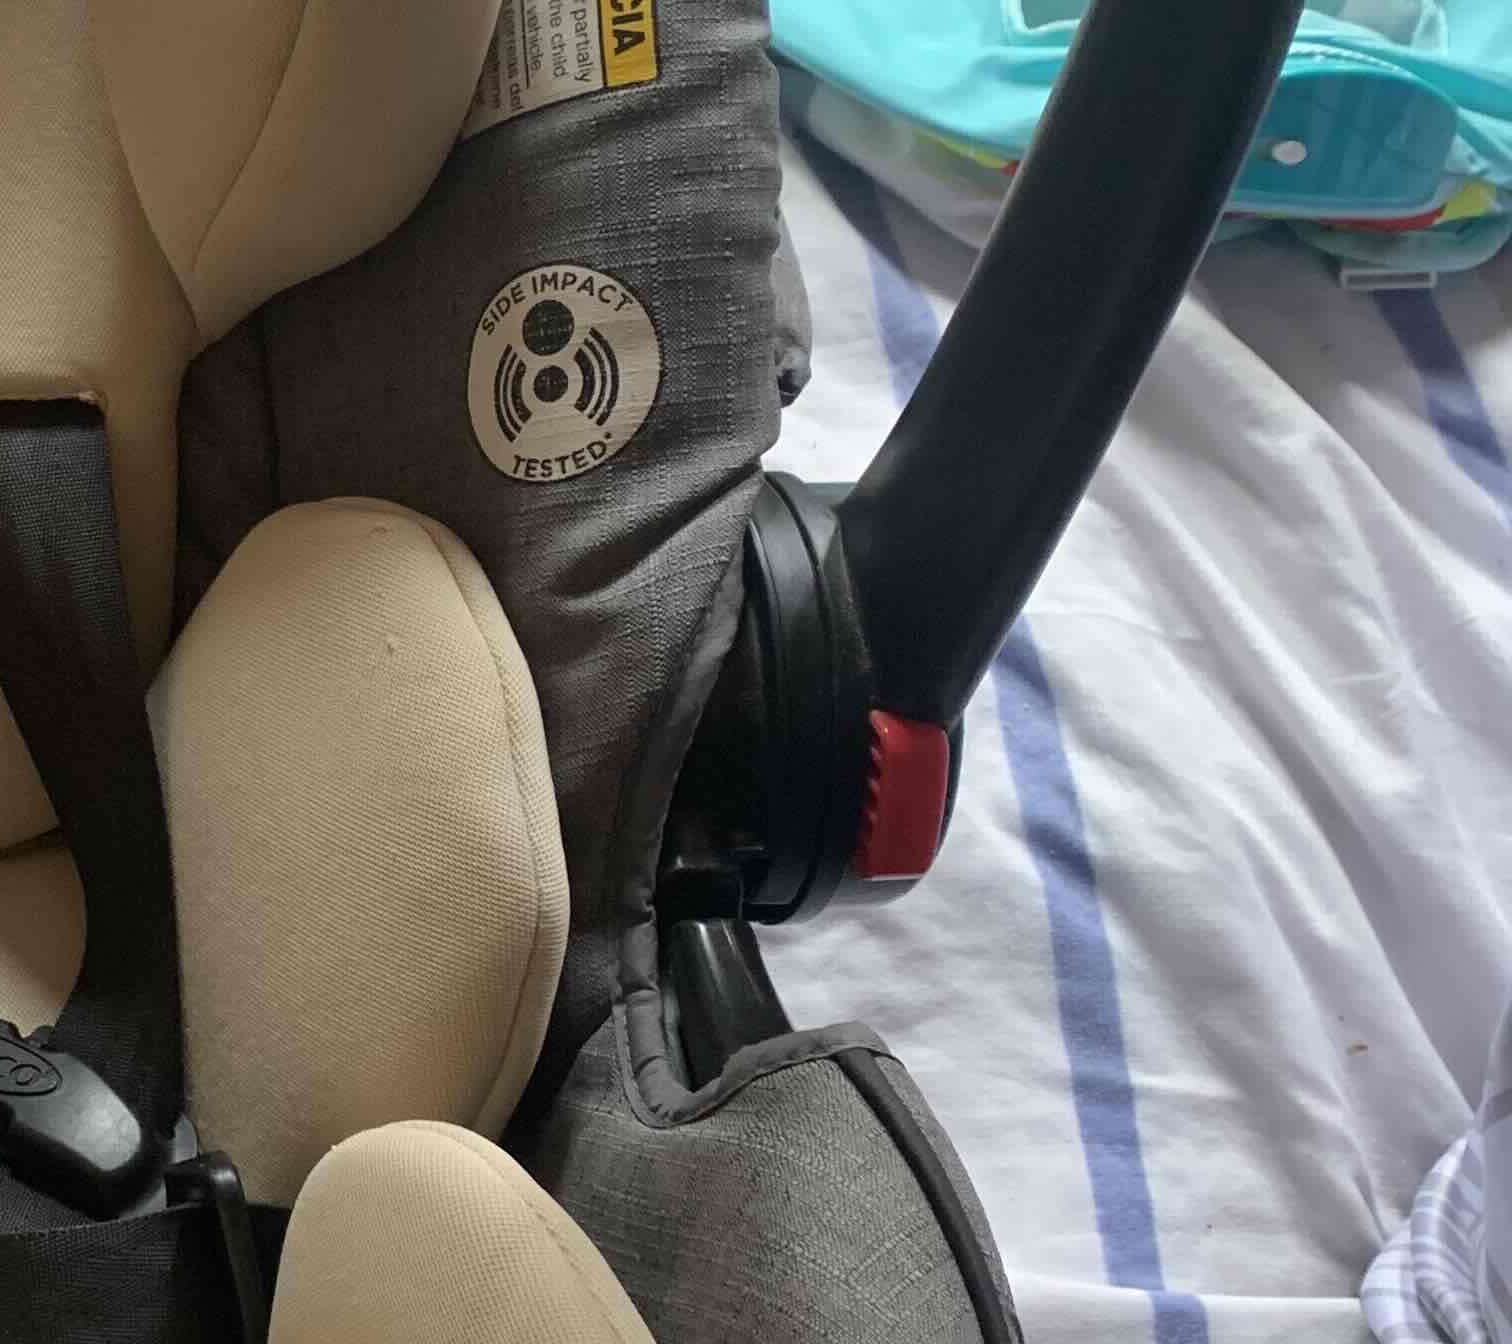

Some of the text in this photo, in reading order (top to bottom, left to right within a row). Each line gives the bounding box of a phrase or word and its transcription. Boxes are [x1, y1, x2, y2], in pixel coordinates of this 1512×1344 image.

[550, 33, 568, 78] child
[568, 8, 594, 83] partially
[481, 271, 633, 336] SIDE IMPACT
